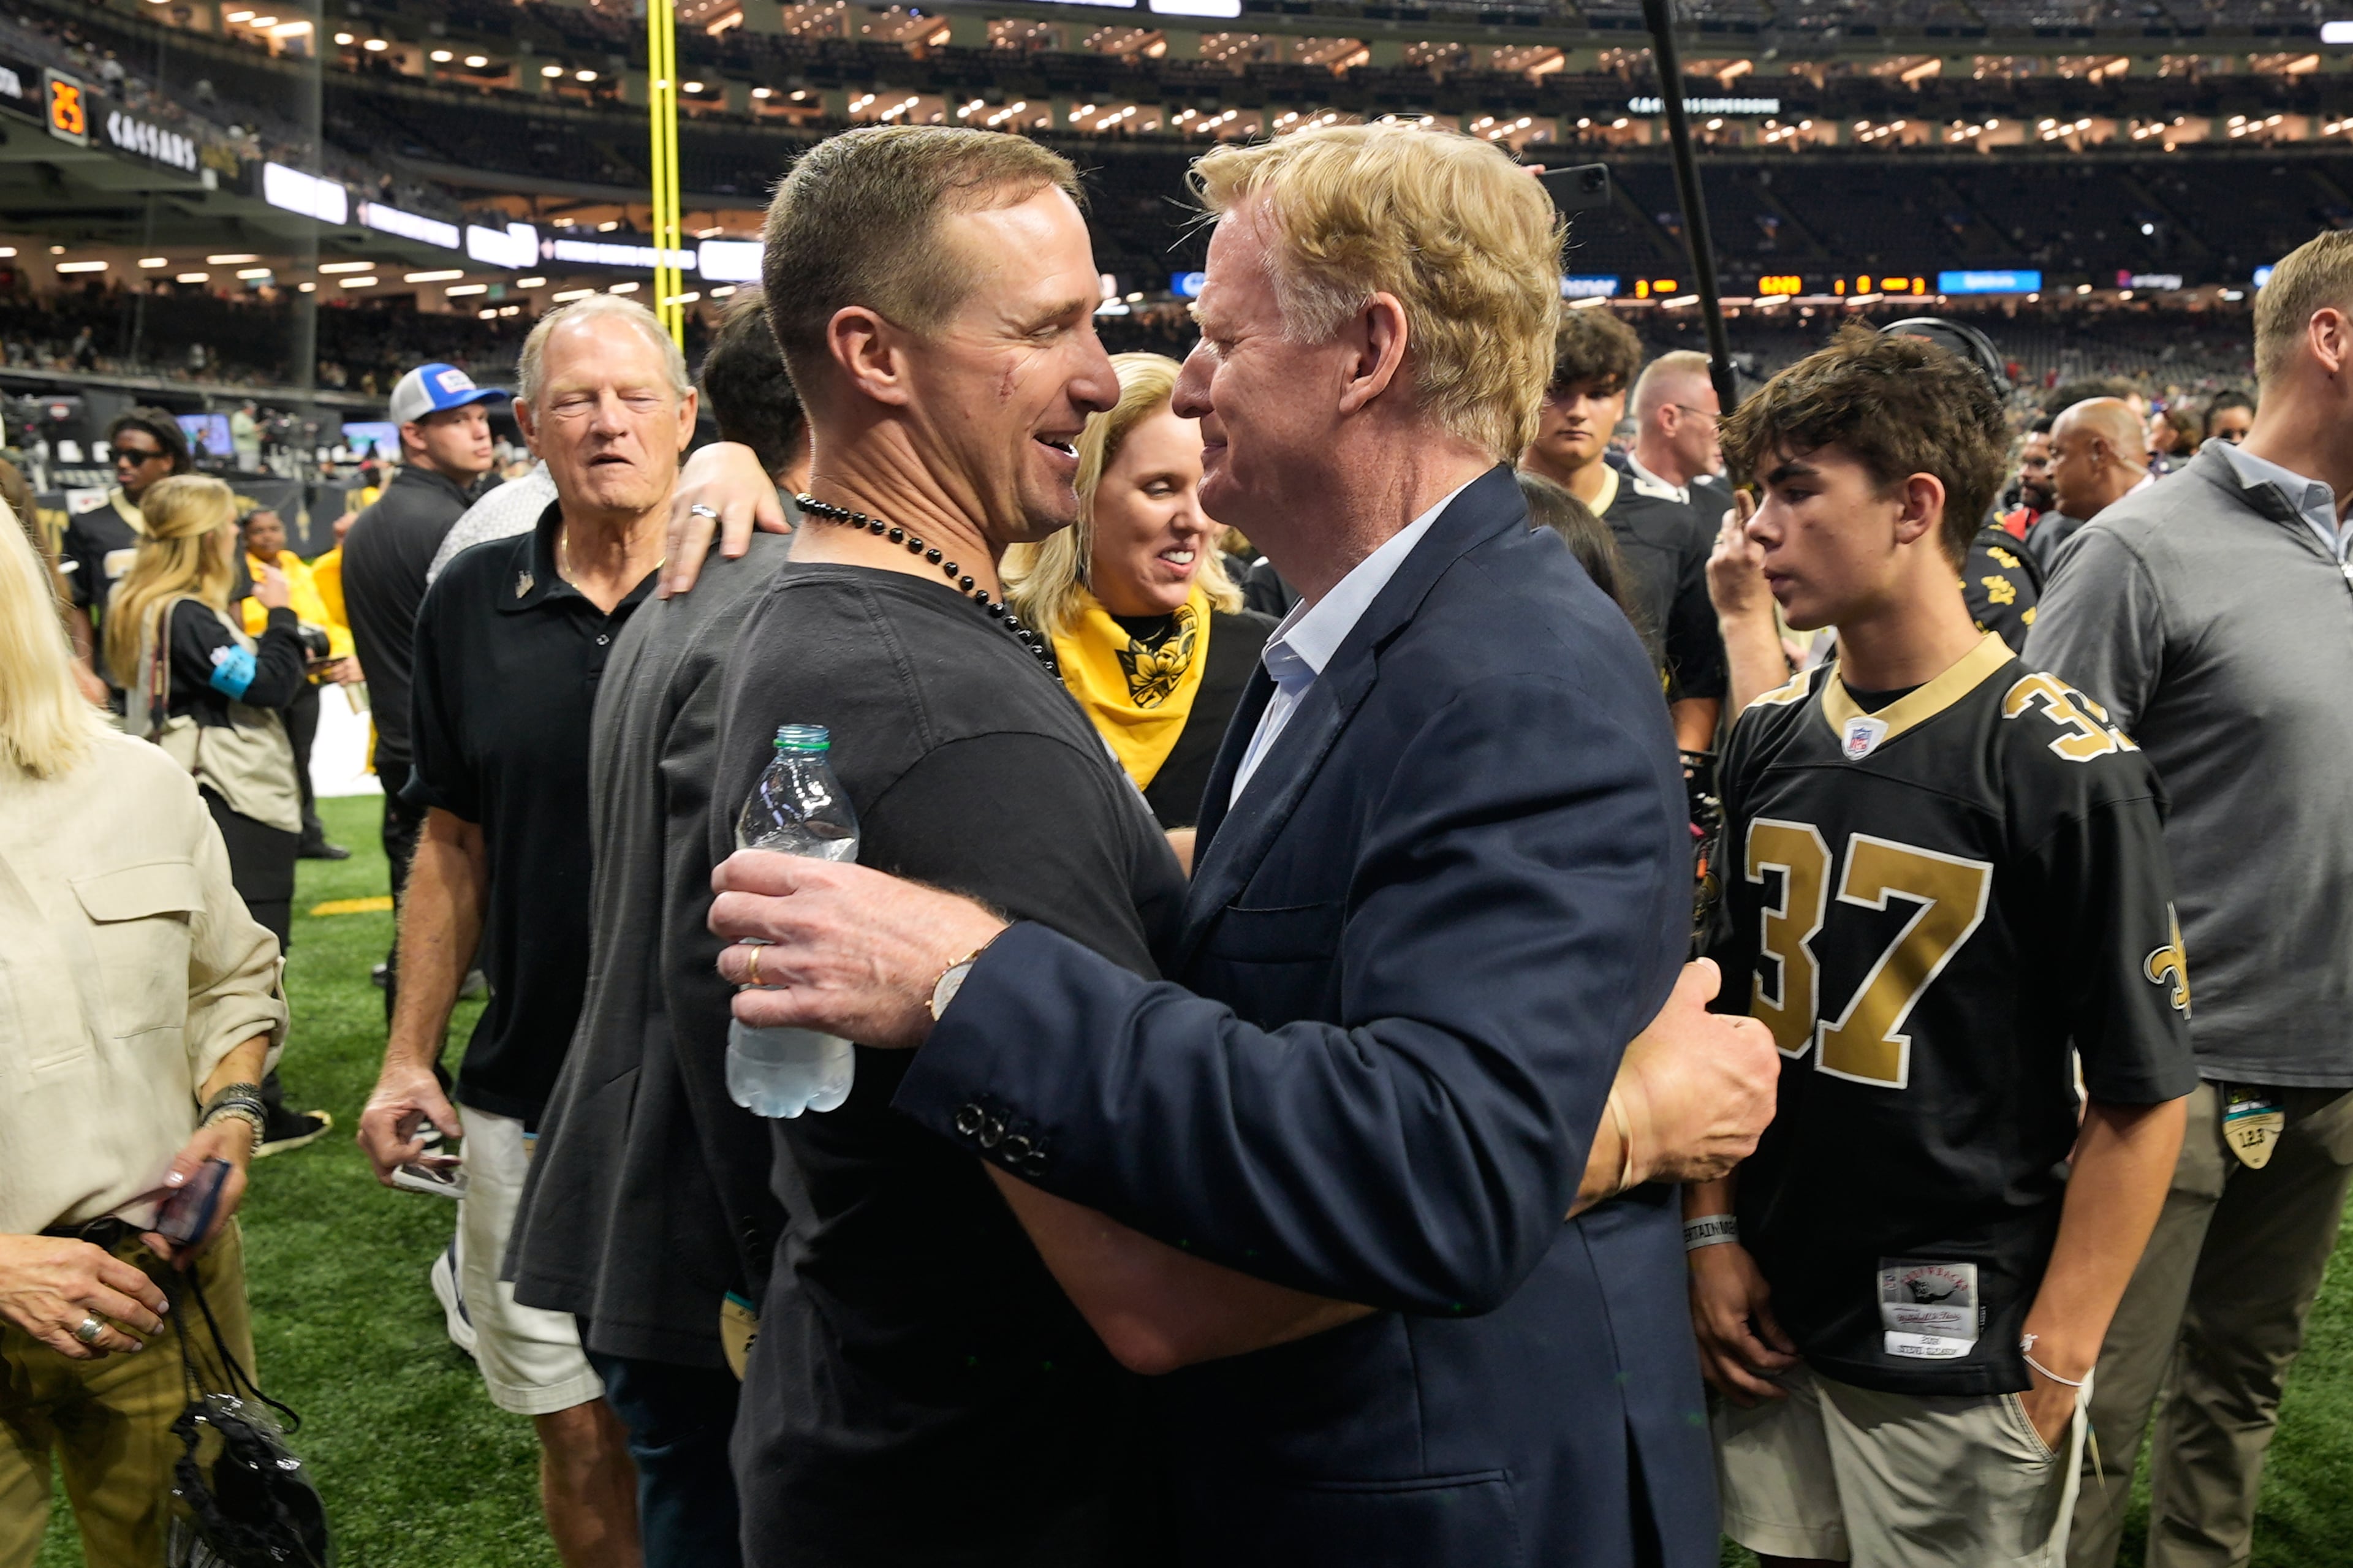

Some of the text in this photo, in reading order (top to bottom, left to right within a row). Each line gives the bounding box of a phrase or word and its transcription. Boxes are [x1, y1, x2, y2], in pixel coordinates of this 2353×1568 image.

[1701, 97, 1780, 115] SUPERDOME
[107, 110, 197, 172] CAESARS
[1744, 817, 1993, 1090] 37
